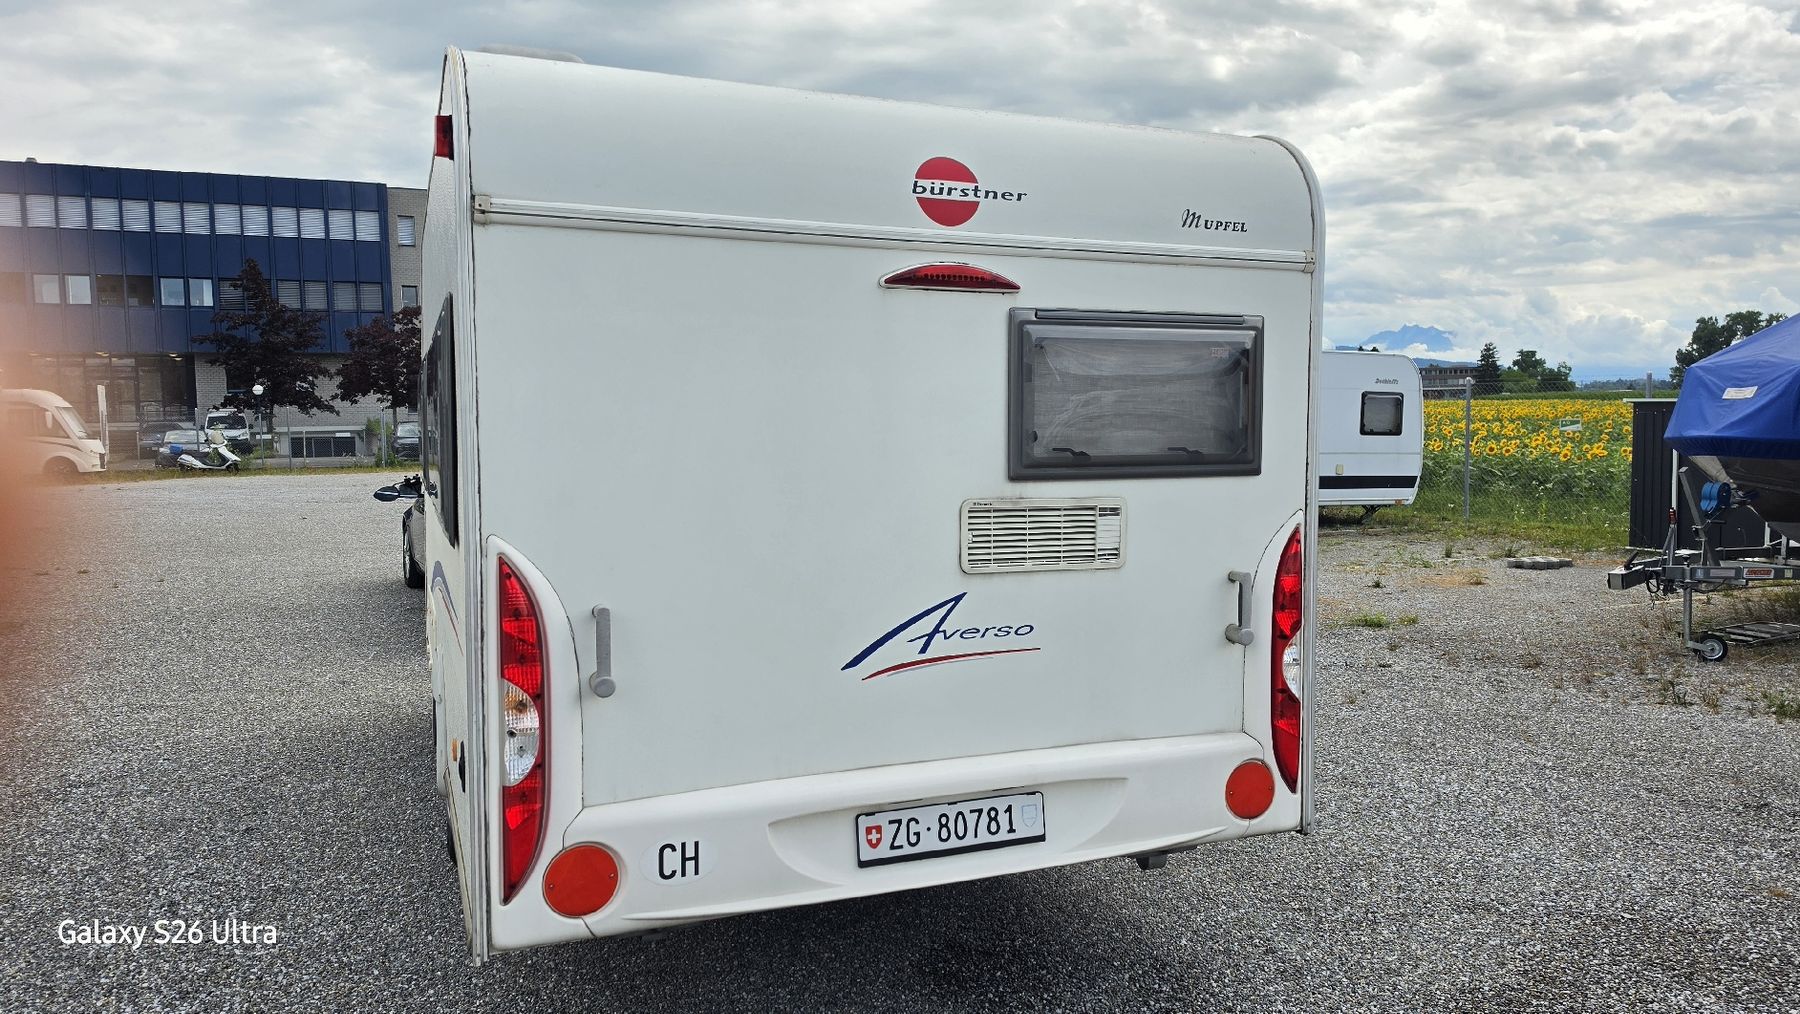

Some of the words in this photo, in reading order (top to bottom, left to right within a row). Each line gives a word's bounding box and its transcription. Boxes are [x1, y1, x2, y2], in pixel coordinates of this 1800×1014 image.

[912, 180, 1028, 202] bürstner
[840, 592, 1035, 671] Averso
[658, 840, 700, 880] CH
